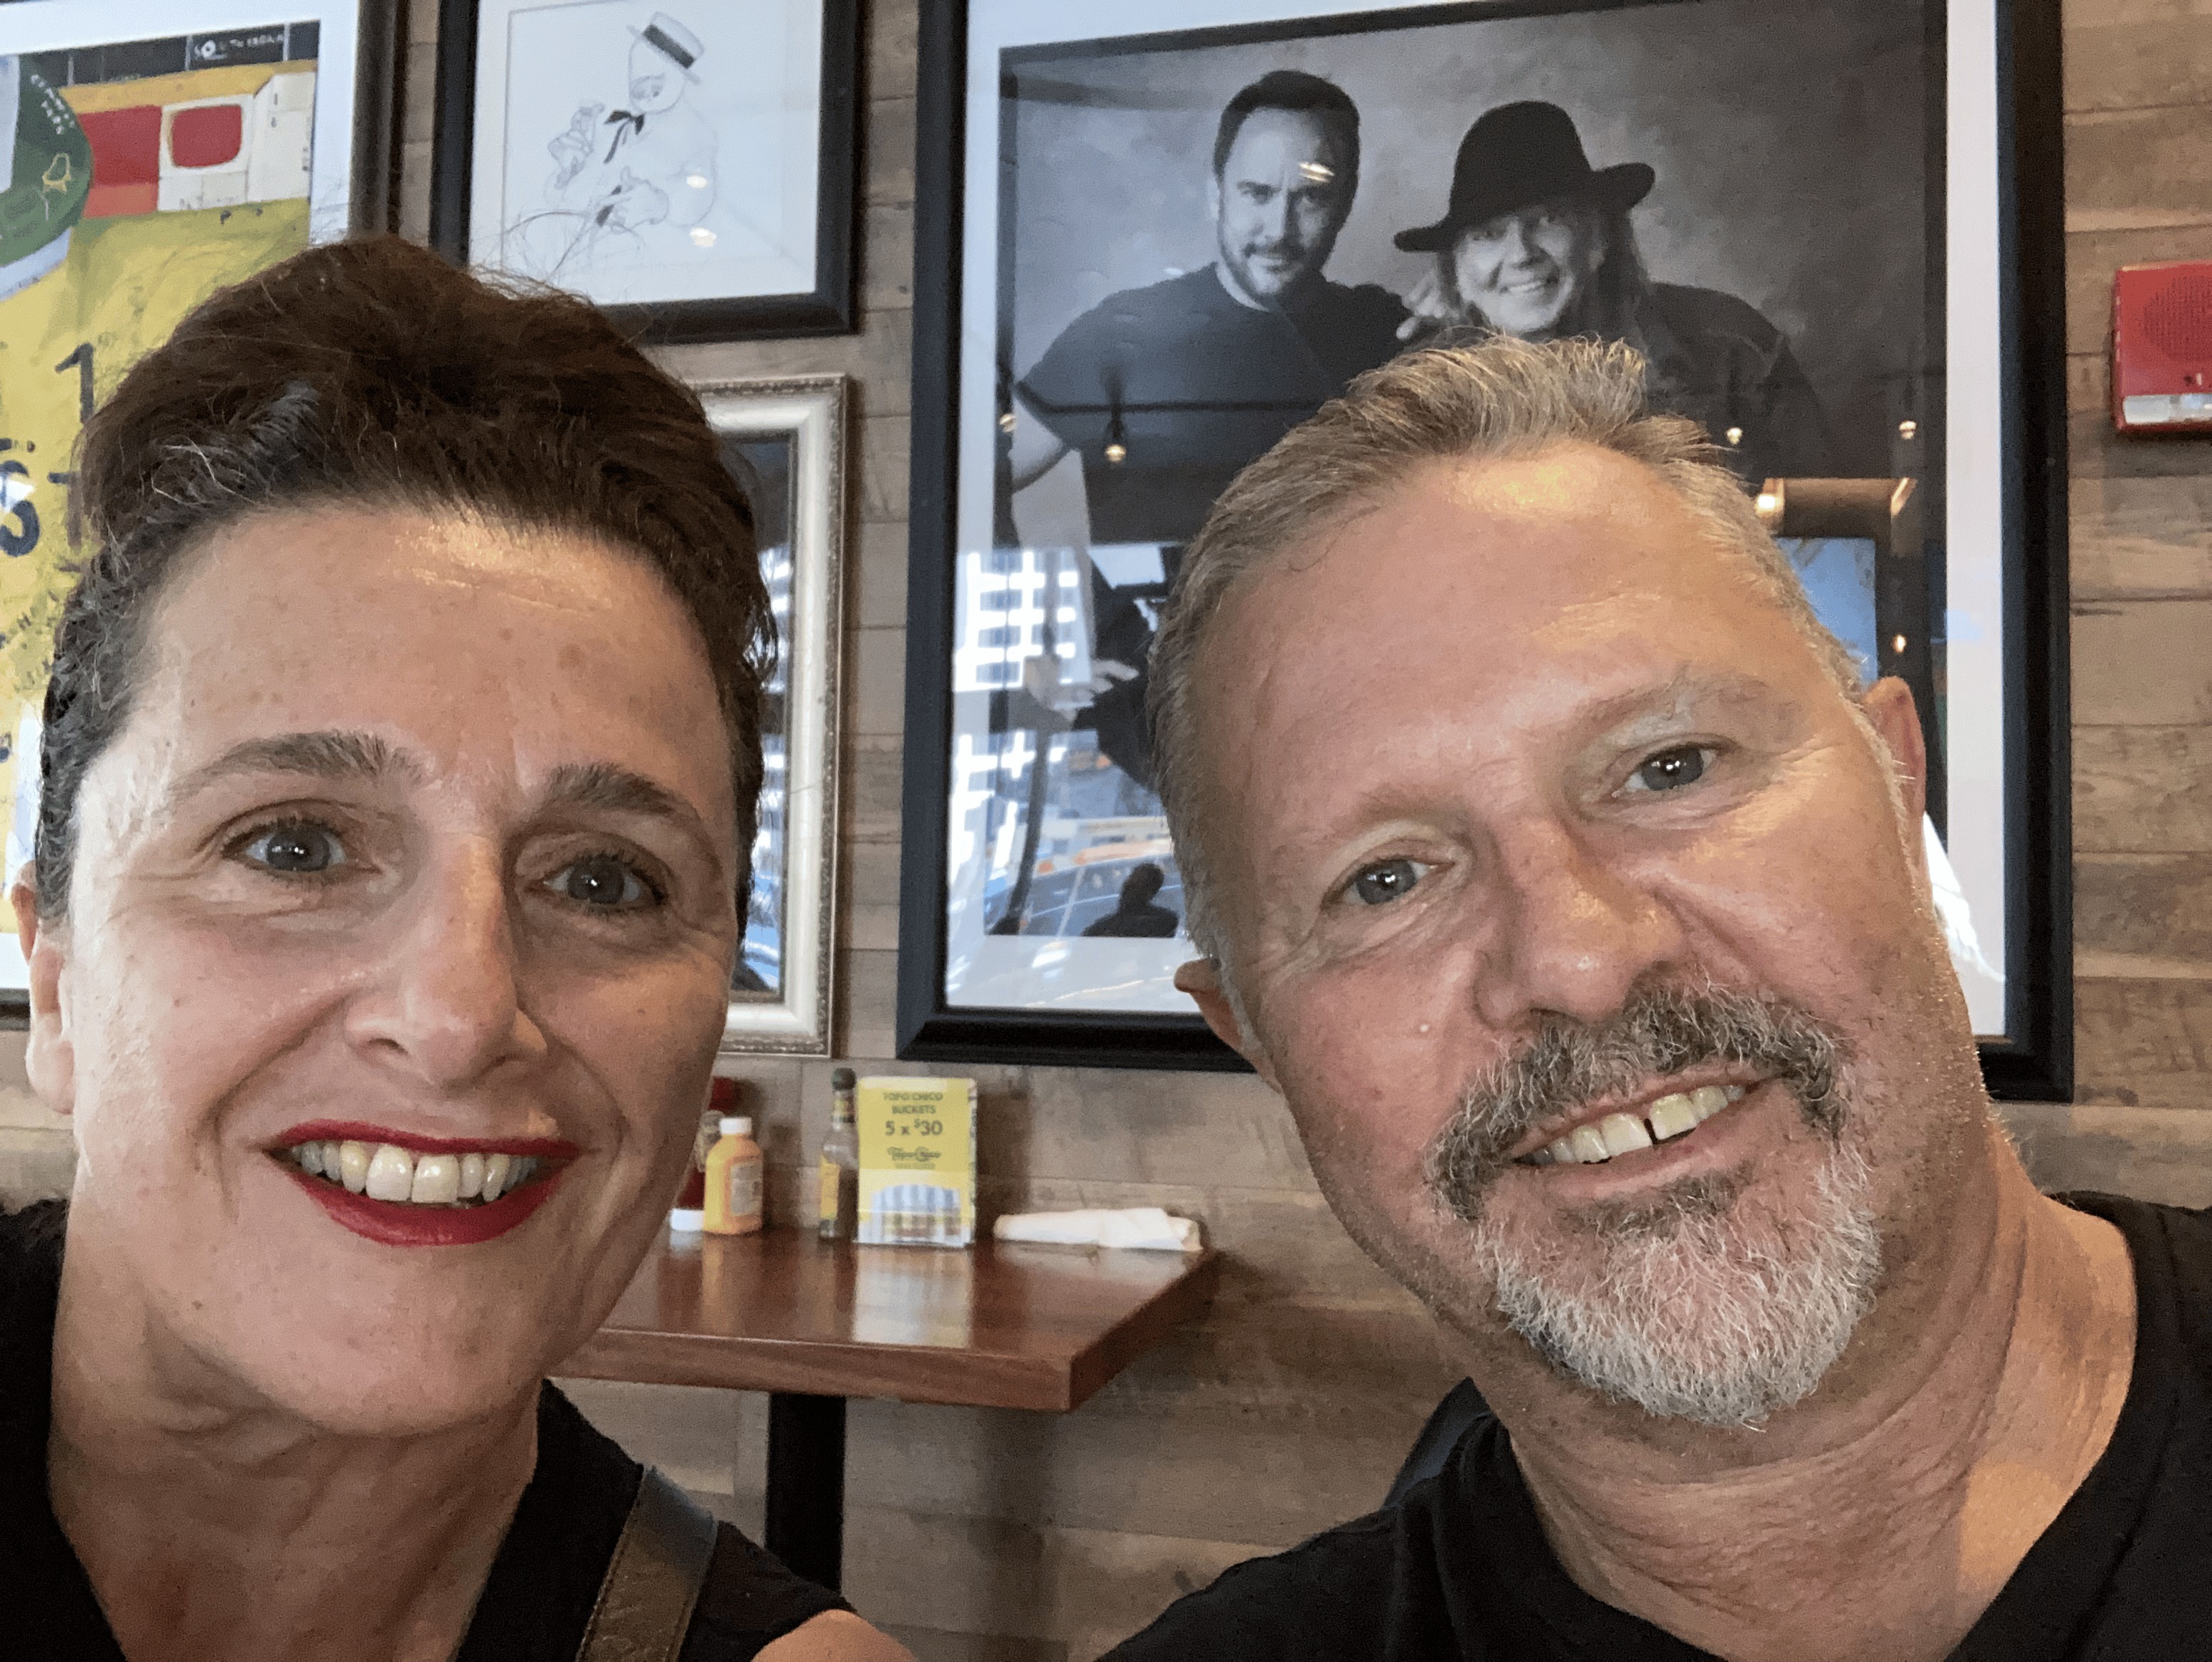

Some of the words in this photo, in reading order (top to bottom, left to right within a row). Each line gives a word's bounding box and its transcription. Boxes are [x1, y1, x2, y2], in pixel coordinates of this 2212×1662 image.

[883, 1092, 910, 1102] TOPO
[912, 1092, 943, 1102] CHICO
[892, 1105, 937, 1115] BUCKETS
[885, 1120, 895, 1136] 5
[913, 1118, 943, 1136] $30
